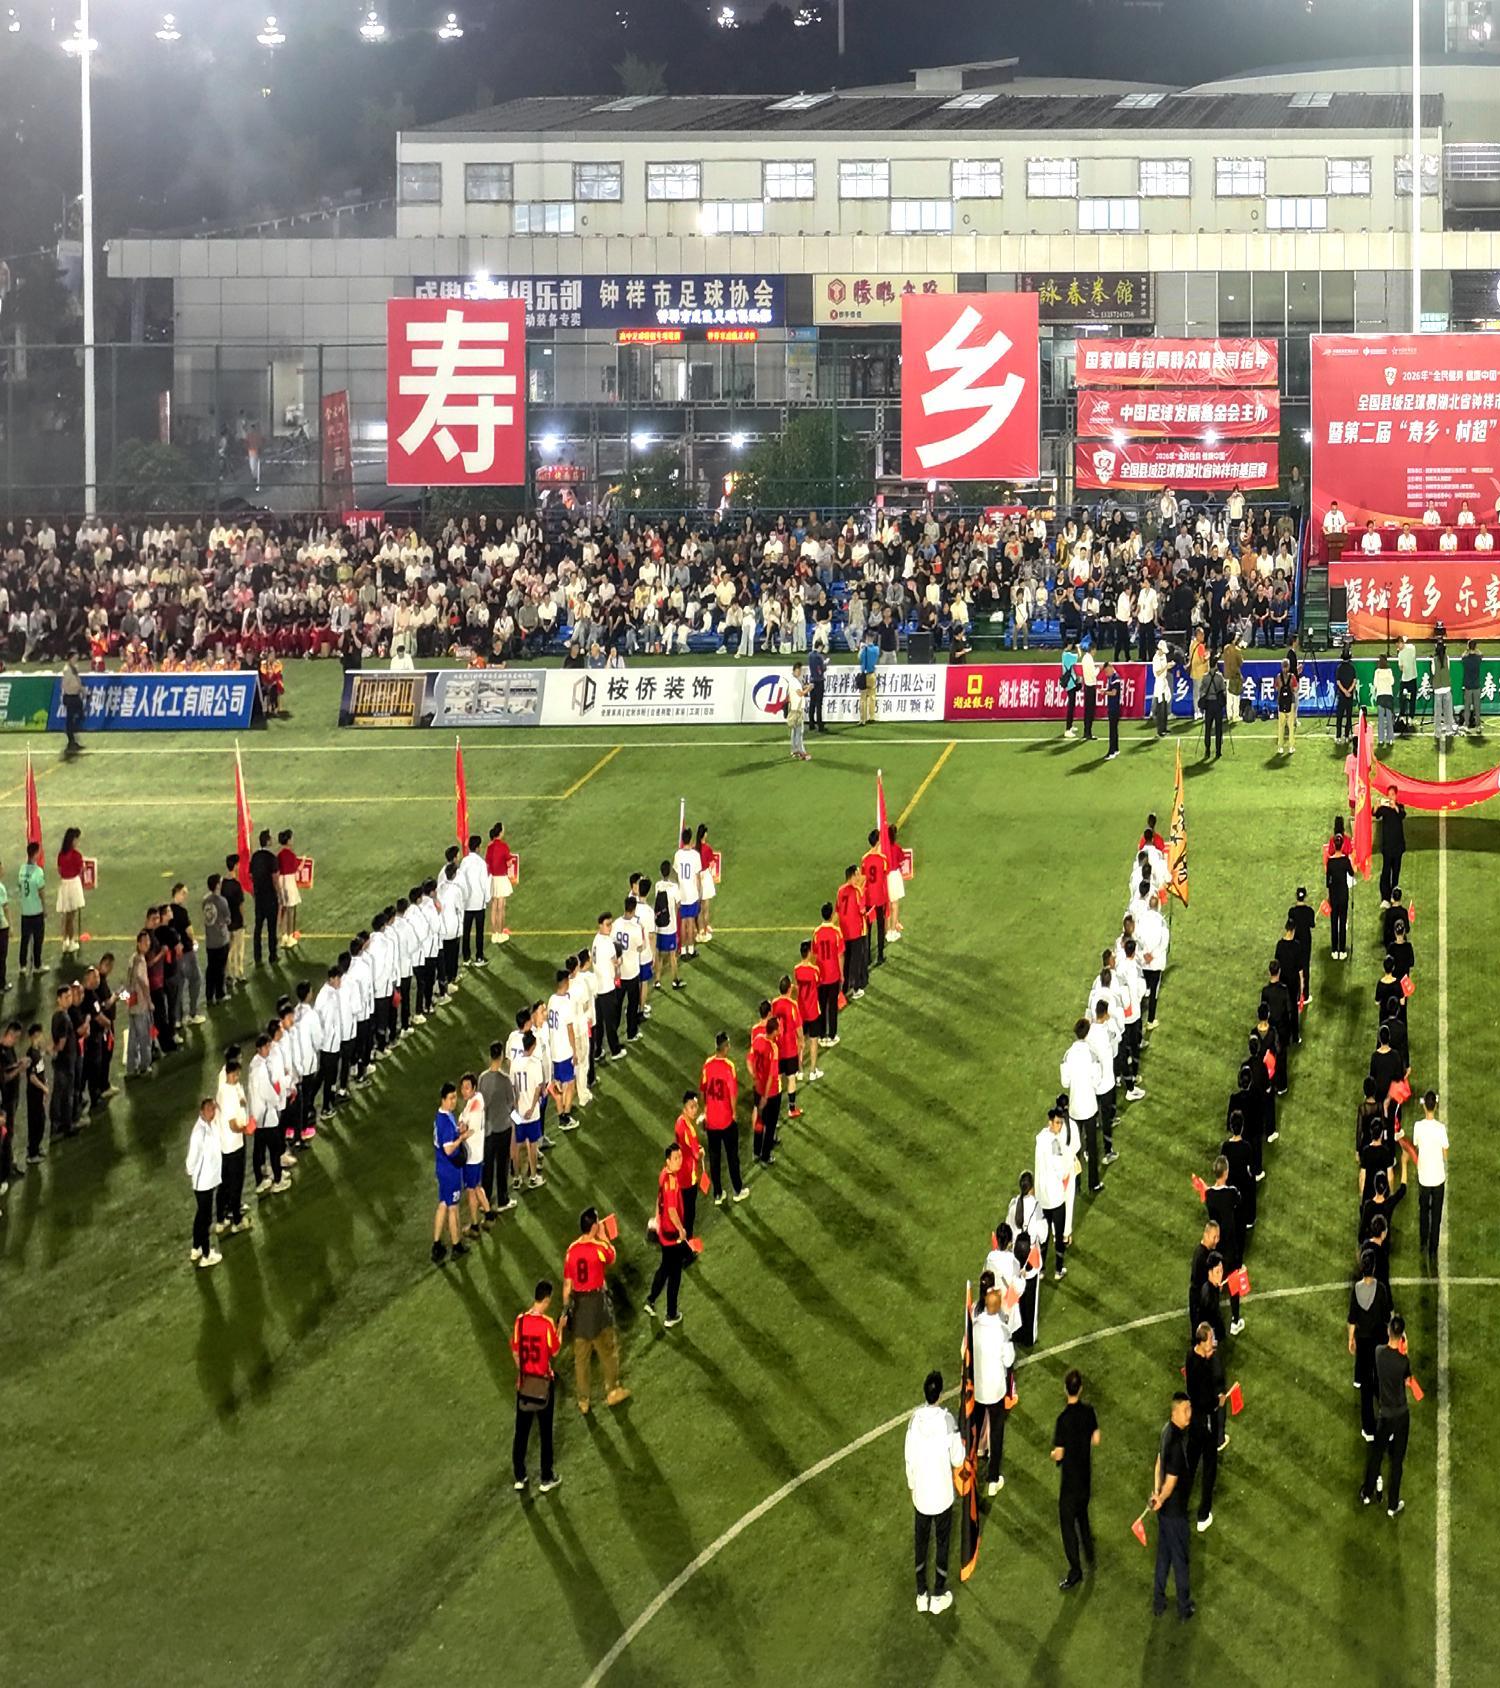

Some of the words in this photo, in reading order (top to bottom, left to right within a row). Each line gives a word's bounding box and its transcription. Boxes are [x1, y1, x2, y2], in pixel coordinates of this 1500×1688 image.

[599, 279, 774, 309] 钟祥市足球协会
[397, 309, 517, 474] 寿
[915, 305, 1026, 469] 乡
[1120, 403, 1268, 422] 中国足球发展基金会主办
[57, 684, 247, 718] 钟祥喜人化工有限公司
[607, 676, 714, 701] 桉侨装饰
[999, 679, 1040, 709] 湖北银行
[953, 695, 995, 711] 湖北银行
[680, 862, 692, 881] 10
[616, 931, 630, 951] 99
[576, 1258, 588, 1283] 8
